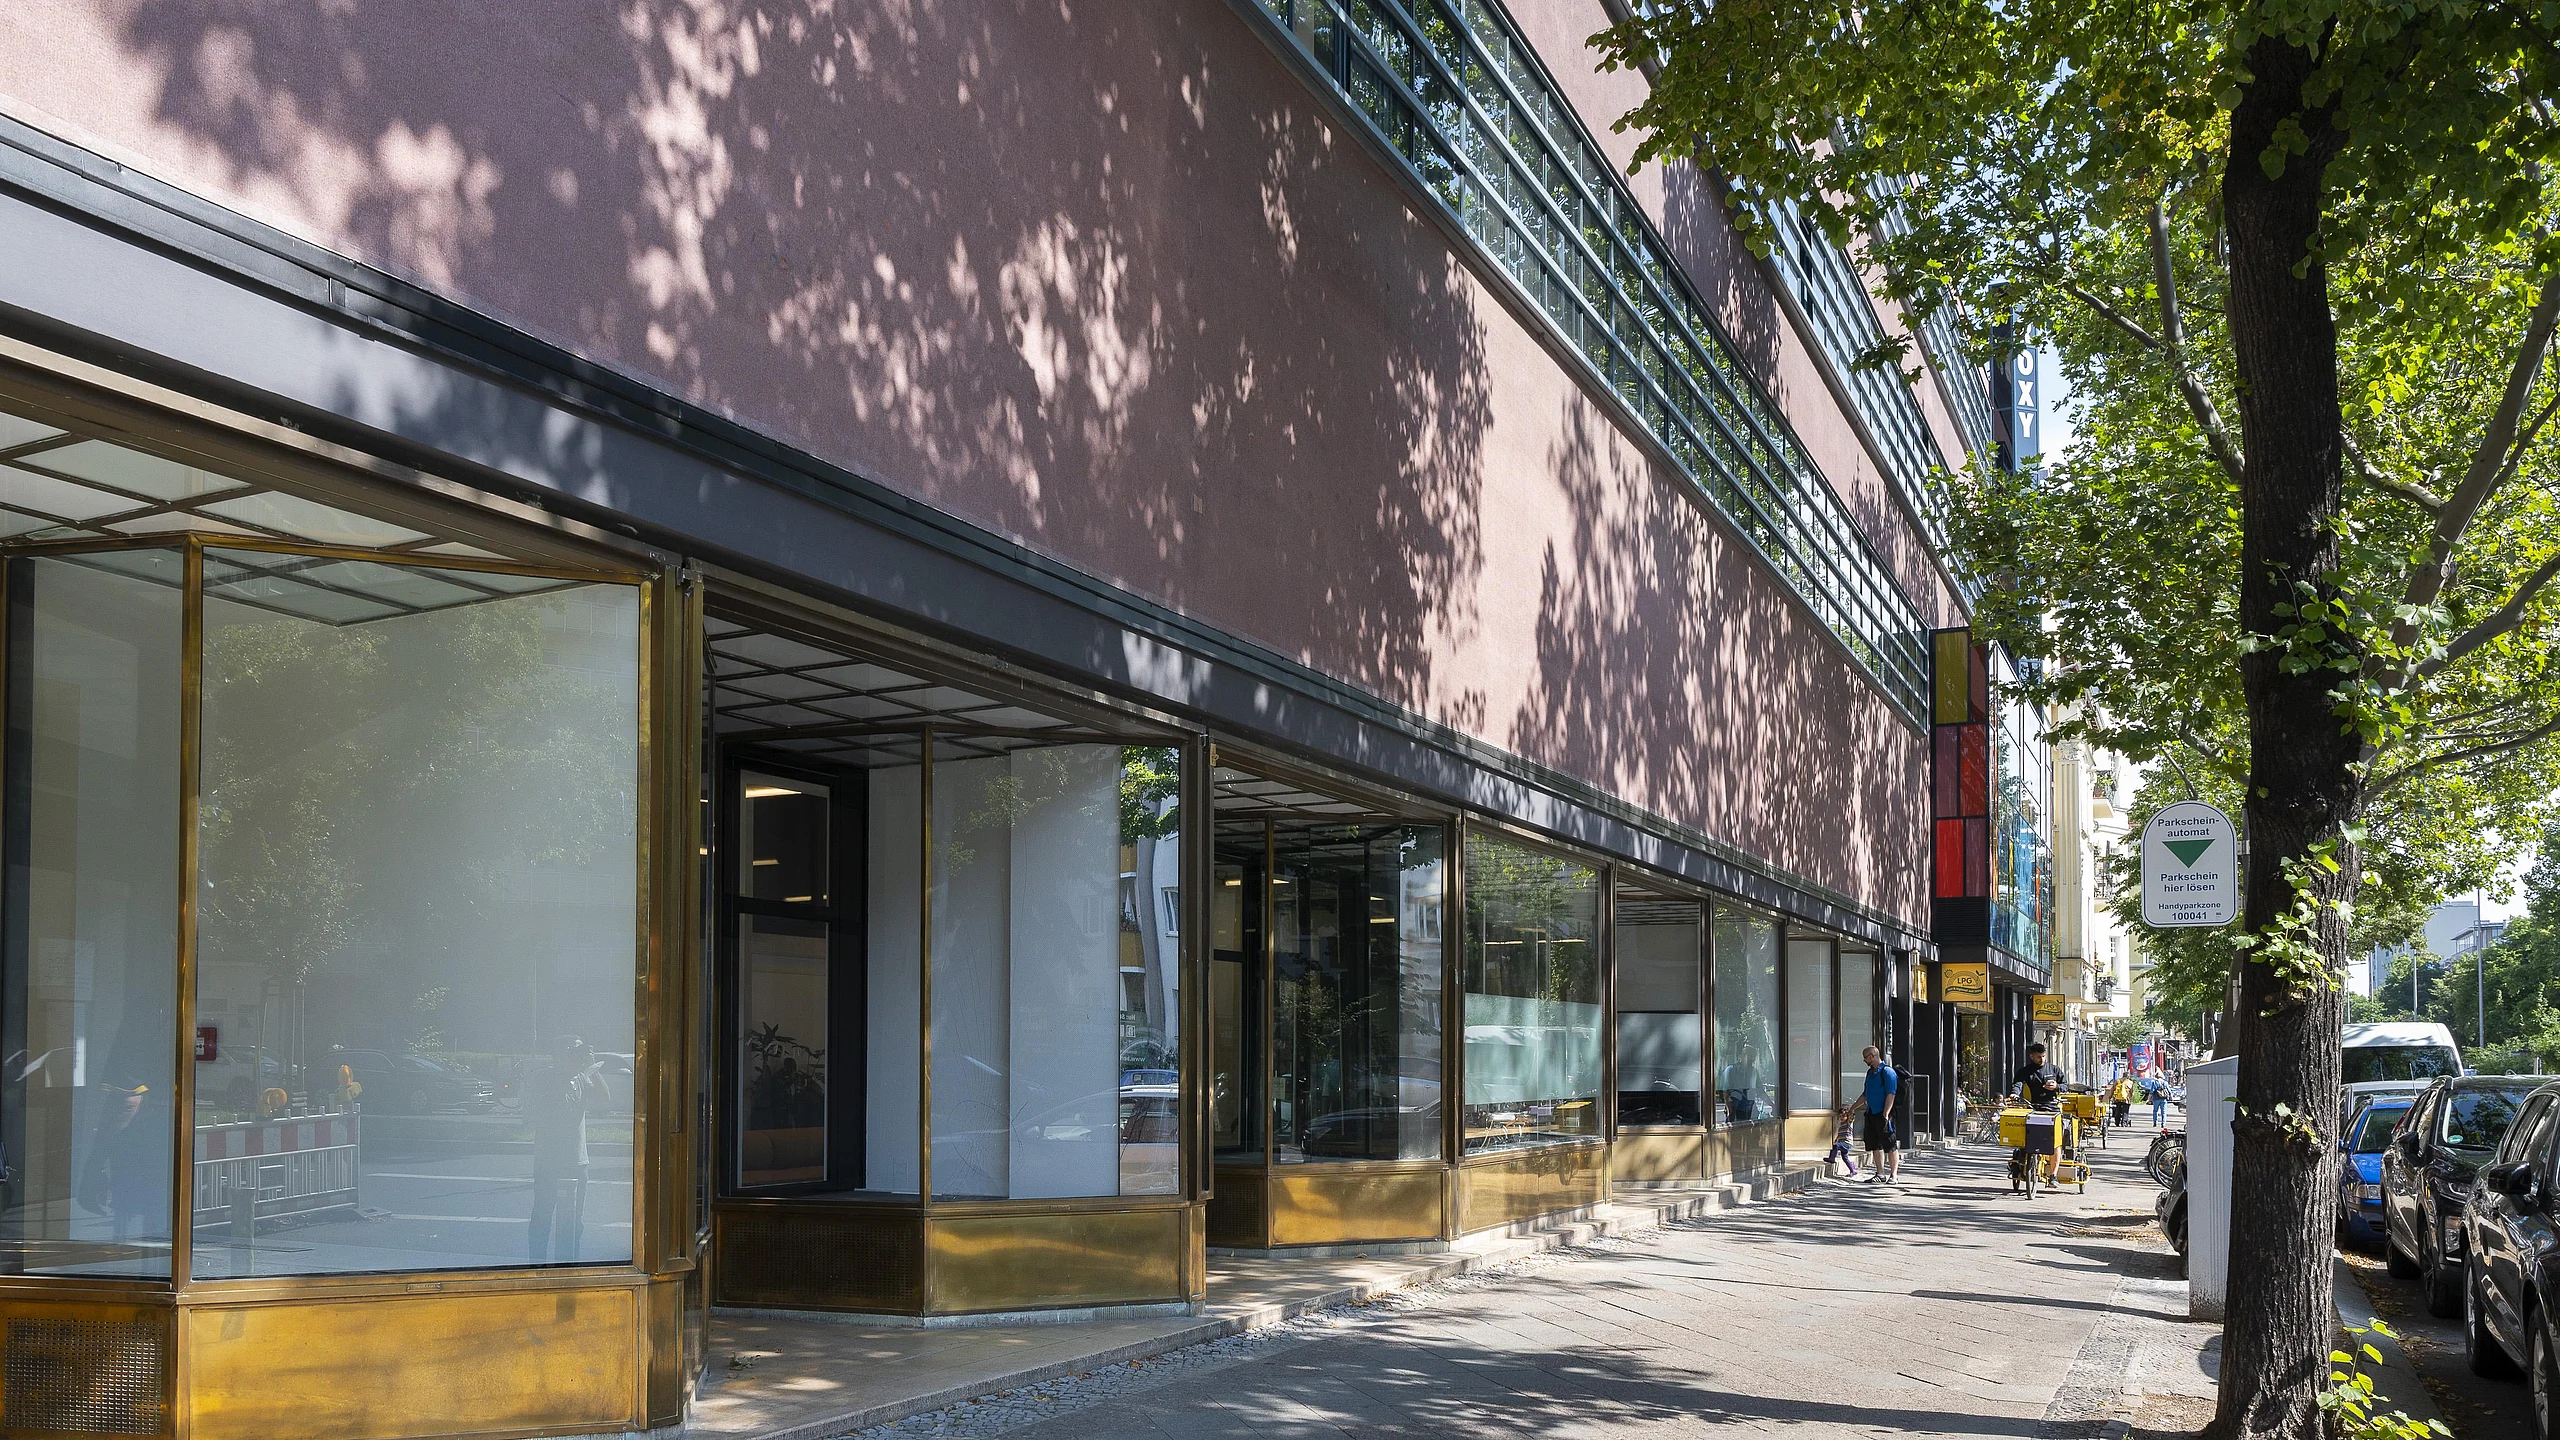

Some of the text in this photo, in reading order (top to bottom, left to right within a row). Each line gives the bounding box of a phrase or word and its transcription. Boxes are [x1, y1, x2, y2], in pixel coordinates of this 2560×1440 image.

[2158, 816, 2220, 827] Parkschein-
[2167, 828, 2210, 837] automat
[2160, 872, 2218, 882] Parkschein
[2164, 883, 2215, 892] hier lösen
[2158, 902, 2221, 911] Handyparkzone
[2172, 911, 2207, 920] 100041
[1957, 977, 1973, 985] LPG
